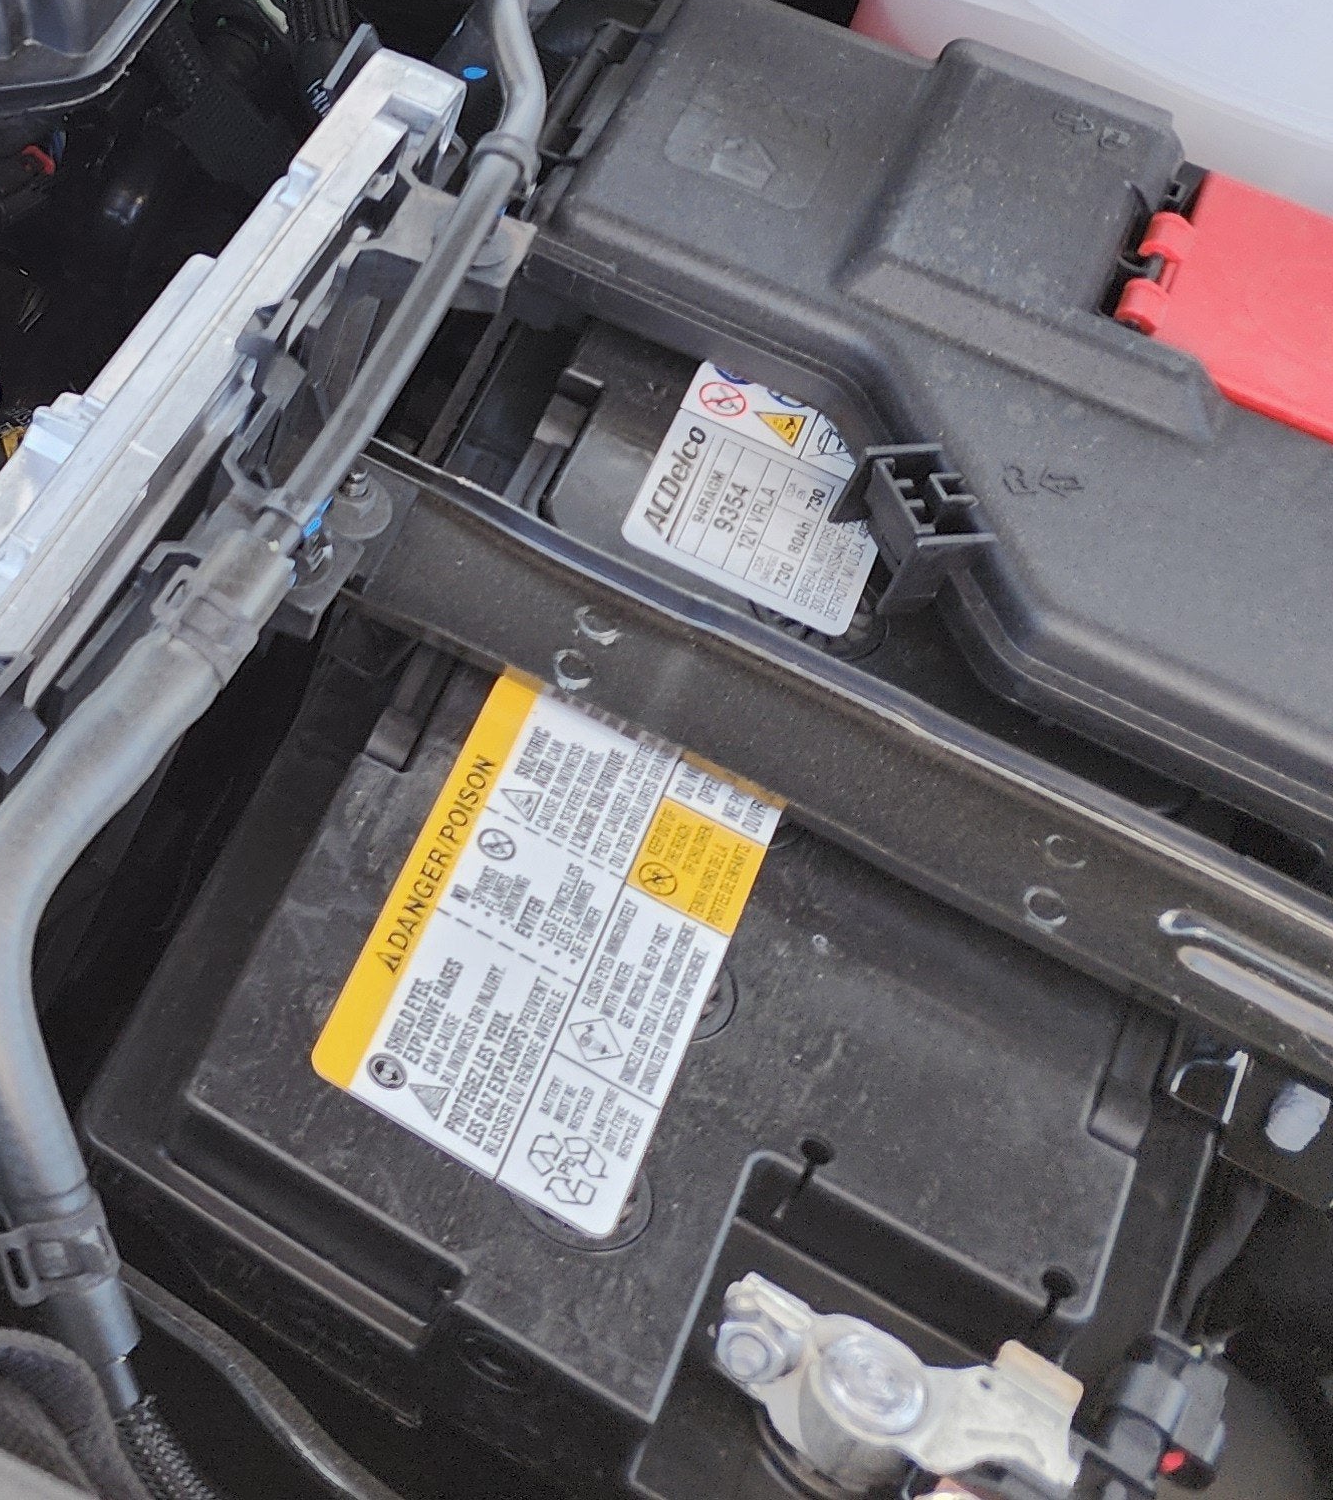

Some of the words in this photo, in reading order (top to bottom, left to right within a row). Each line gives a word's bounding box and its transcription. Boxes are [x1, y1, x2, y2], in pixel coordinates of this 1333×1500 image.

[643, 425, 706, 535] ACDelco
[712, 480, 751, 534] 9354
[747, 483, 777, 526] VRLA
[805, 486, 826, 514] 730
[736, 524, 760, 553] 12V
[773, 561, 794, 588] 730
[793, 562, 822, 607] GENERAL
[810, 523, 837, 565] MOTORS
[513, 724, 552, 781] SULFURIC
[543, 737, 567, 763] CAN
[531, 758, 557, 789] ACID
[534, 795, 561, 831] CAUSE
[549, 740, 586, 800] BLINDNESS
[585, 746, 628, 813] SULFURIQUE
[619, 775, 638, 795] LA
[674, 778, 696, 800] DO
[696, 773, 723, 806] OPE
[558, 783, 588, 825] SEVERE
[601, 790, 632, 834] CAUSER
[740, 797, 769, 834] OUVR
[552, 821, 571, 840] OR
[590, 830, 614, 861] PEUT
[615, 829, 636, 853] DES
[385, 752, 497, 954] DANGER/POISON
[608, 849, 627, 869] OU
[484, 872, 514, 914] FLAMES
[536, 918, 558, 943] LES
[553, 927, 574, 951] LES
[569, 940, 587, 959] DE
[401, 994, 447, 1066] EXPLOSIVE
[432, 955, 465, 1000] GASES
[516, 974, 552, 1030] PEUVENT
[383, 1006, 418, 1056] SHIELD
[432, 1010, 462, 1052] CAUSE
[439, 1020, 479, 1087] BLINDNESS
[467, 1003, 487, 1025] OR
[421, 1047, 446, 1076] CAN
[471, 1041, 497, 1071] LES
[485, 1023, 529, 1096] EXPLOSIFS
[512, 1037, 545, 1088] RENDRE
[473, 1090, 500, 1122] GAZ
[505, 1083, 525, 1105] OU
[461, 1116, 488, 1148] LES
[481, 1100, 518, 1158] BLESSER
[556, 1152, 577, 1177] Pb
